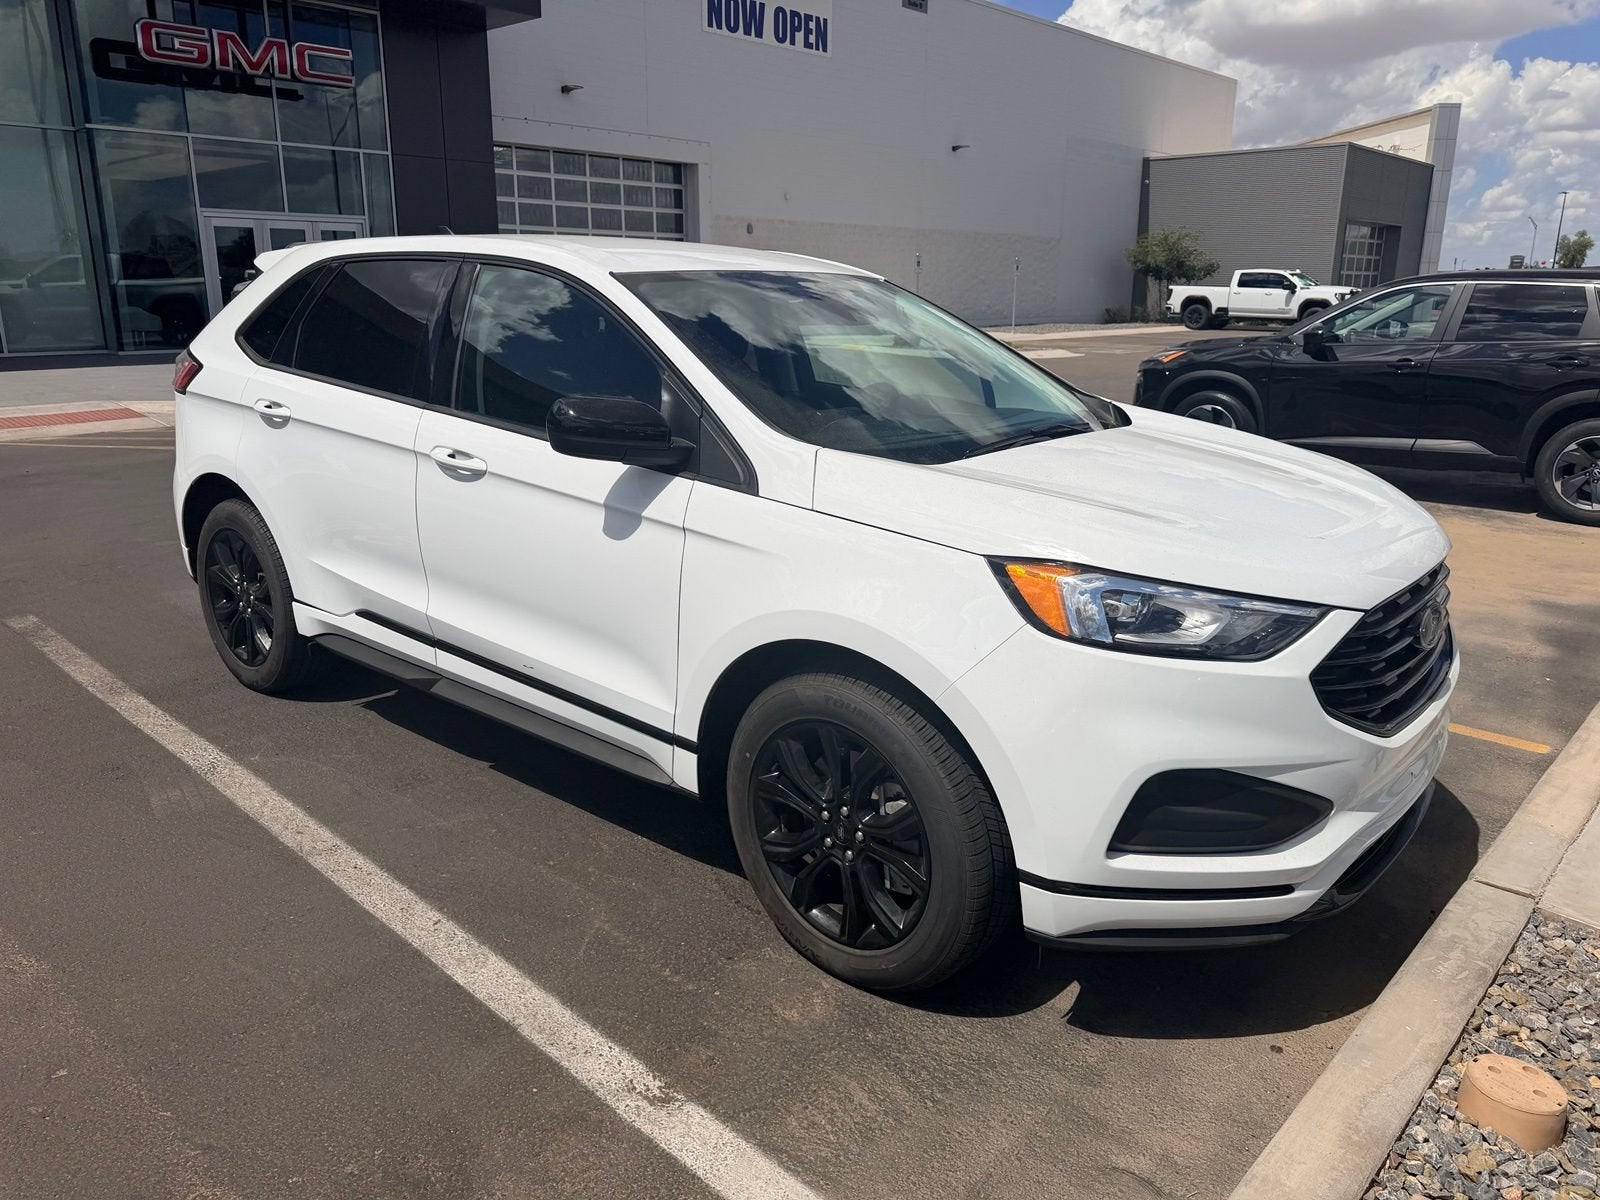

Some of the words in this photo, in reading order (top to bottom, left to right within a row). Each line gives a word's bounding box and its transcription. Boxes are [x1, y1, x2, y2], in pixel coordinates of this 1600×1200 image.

[136, 19, 354, 87] GMC
[706, 0, 766, 39] NOW
[773, 6, 828, 53] OPEN
